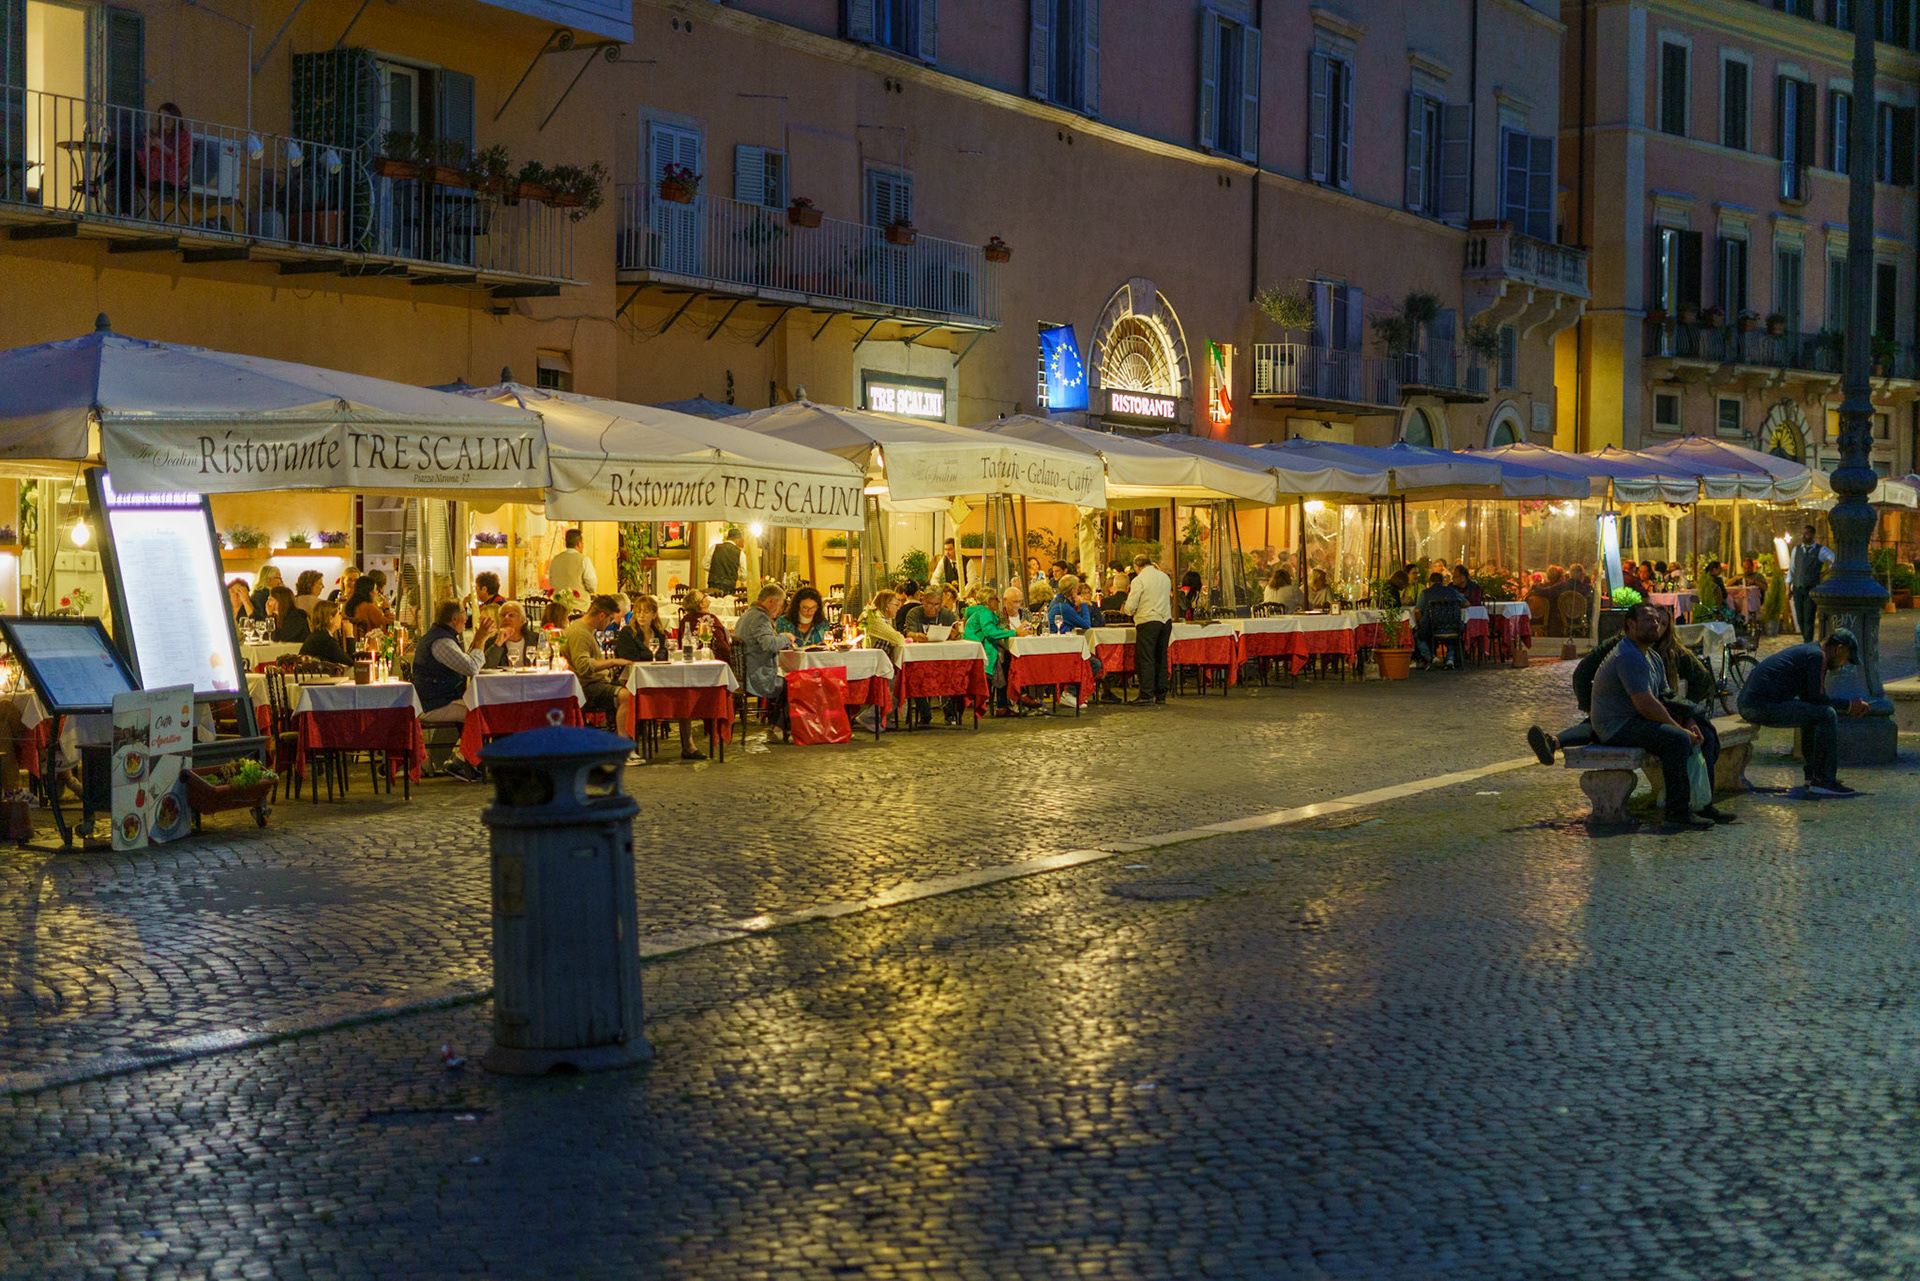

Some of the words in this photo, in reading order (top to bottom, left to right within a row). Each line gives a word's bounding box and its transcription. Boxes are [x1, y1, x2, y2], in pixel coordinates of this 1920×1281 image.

[870, 386, 896, 412] TRE
[896, 389, 943, 417] SCALINI
[1111, 393, 1175, 418] RISTORANTE
[198, 430, 340, 474] Ristorante
[348, 432, 412, 470] TRE
[417, 435, 537, 471] SCALINI
[1027, 460, 1060, 488] Gelato
[607, 469, 716, 508] Ristorante
[721, 475, 767, 510] TRE
[770, 481, 861, 516] SCALINI
